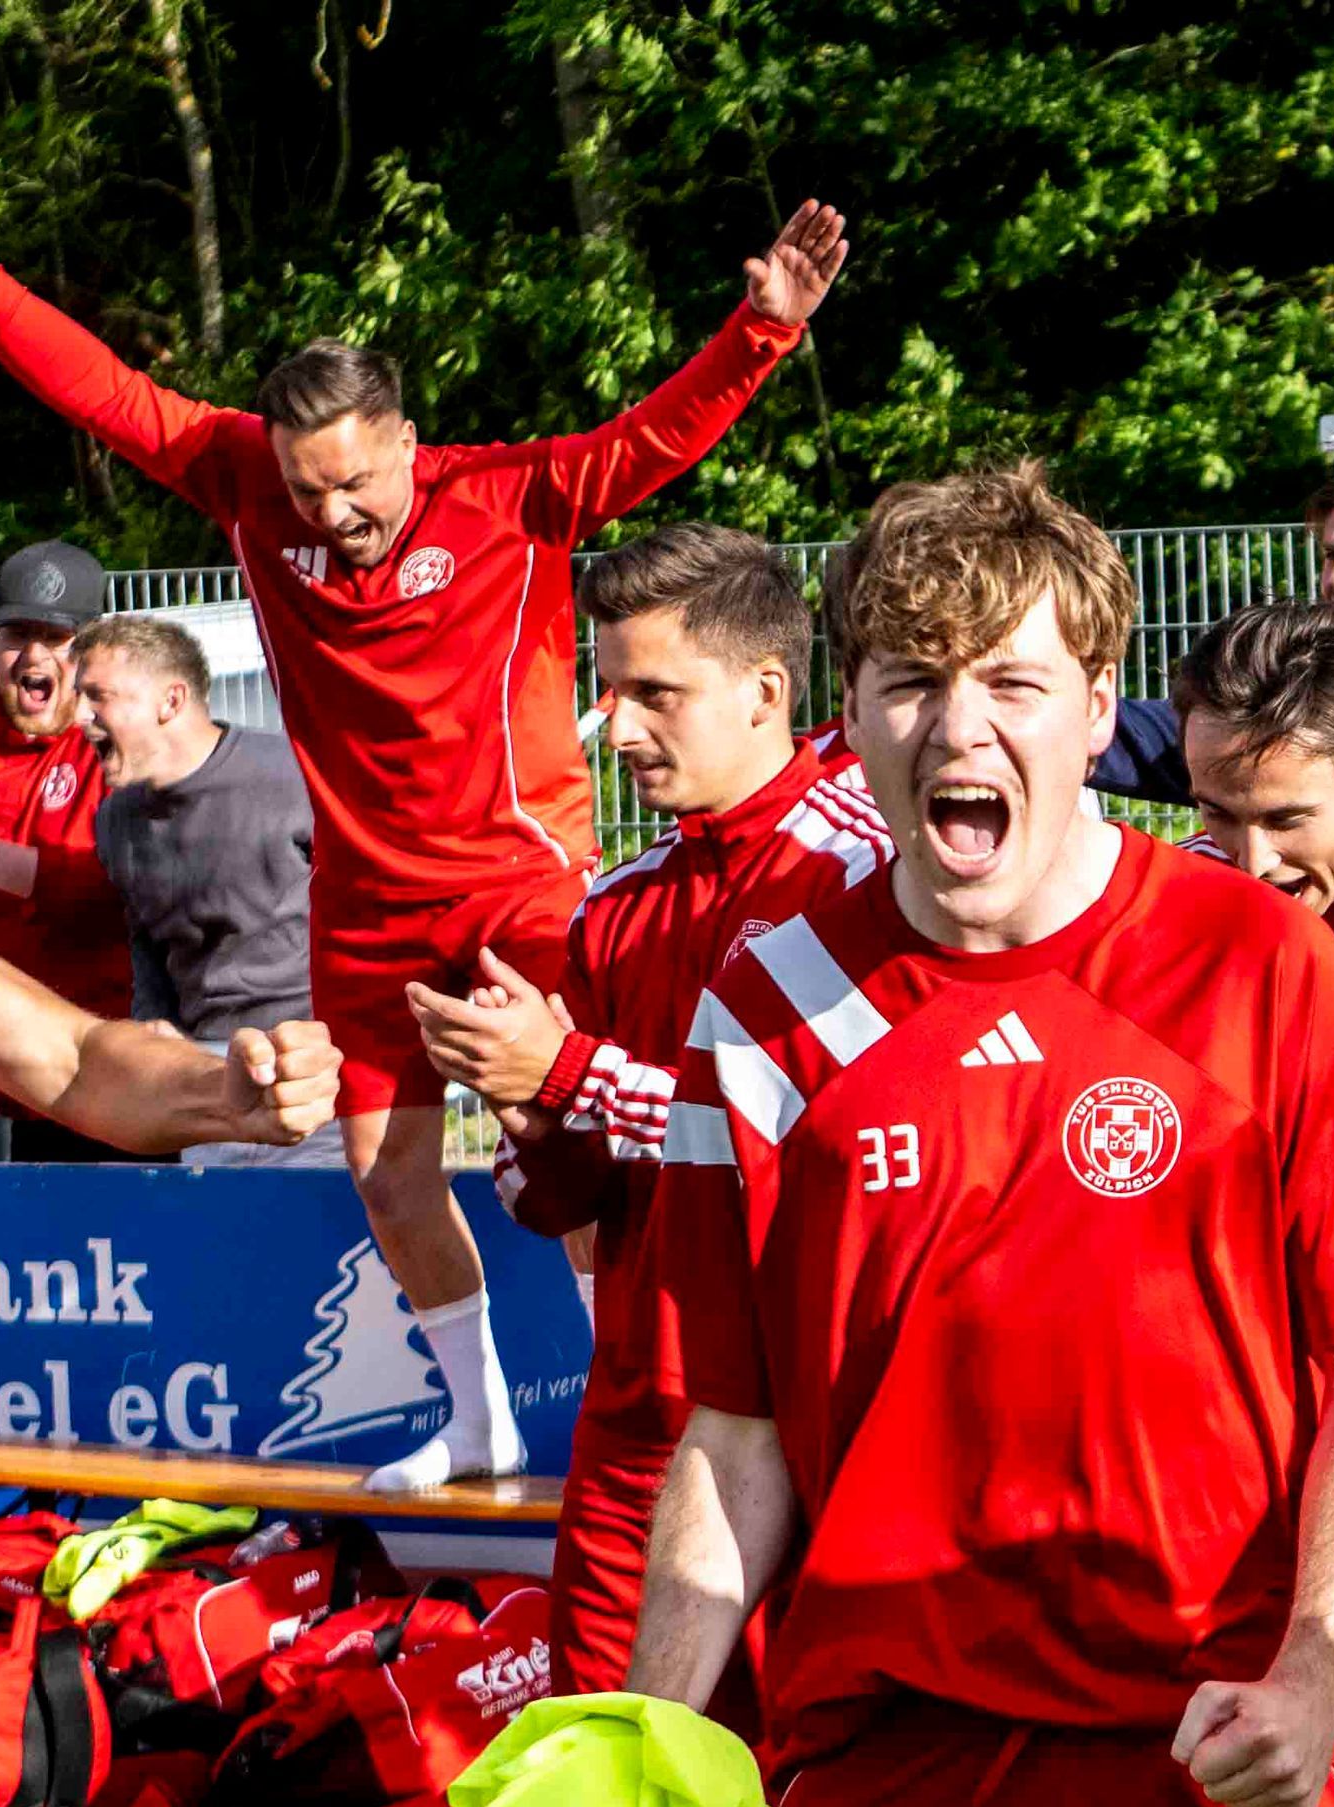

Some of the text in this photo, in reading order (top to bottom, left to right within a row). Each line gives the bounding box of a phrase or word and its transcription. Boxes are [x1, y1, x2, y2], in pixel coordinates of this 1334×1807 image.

[1097, 1082, 1175, 1129] CHLODWIG
[857, 1123, 921, 1192] 33
[109, 1362, 239, 1451] eG
